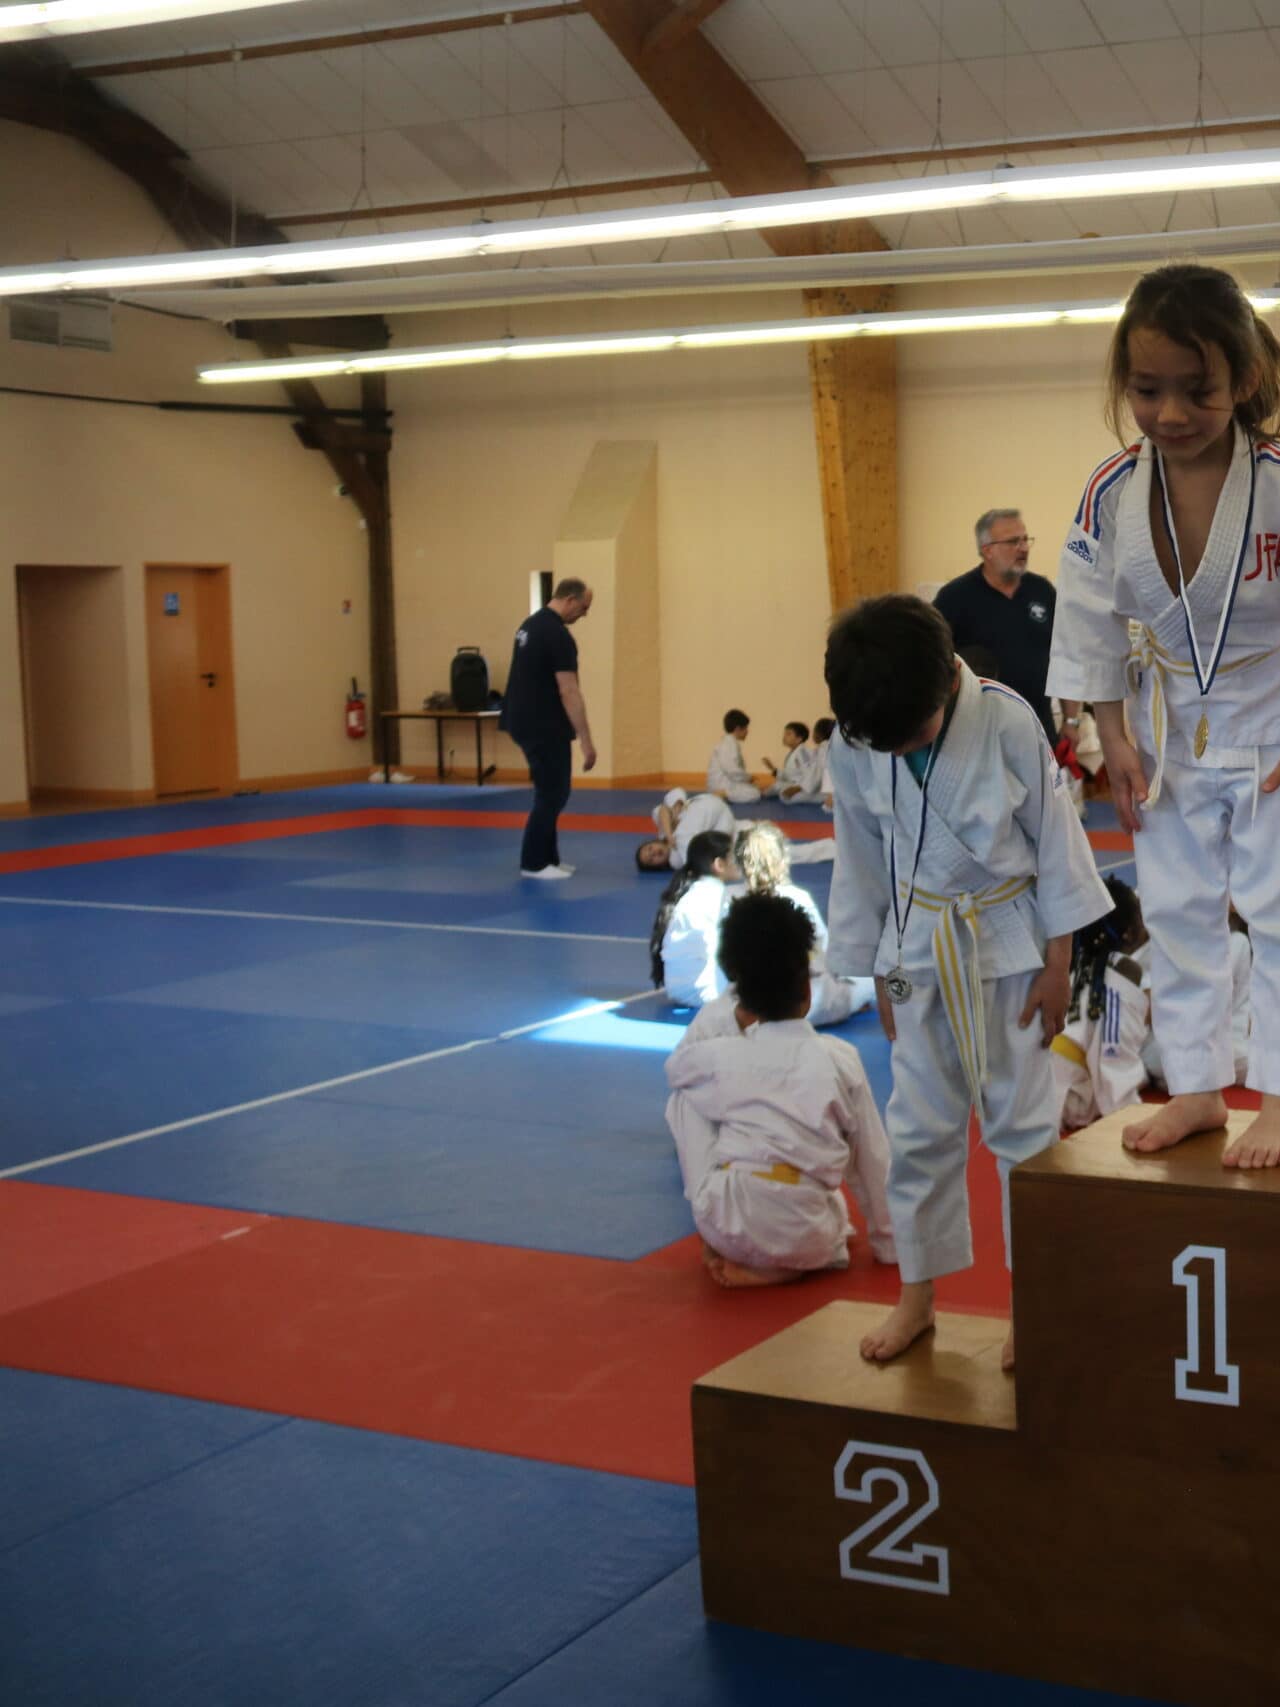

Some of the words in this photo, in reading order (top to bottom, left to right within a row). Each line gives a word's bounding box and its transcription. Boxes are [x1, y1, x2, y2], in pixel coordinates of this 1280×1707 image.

[1067, 543, 1093, 564] adidas
[1171, 1245, 1241, 1407] 1
[833, 1440, 950, 1597] 2
